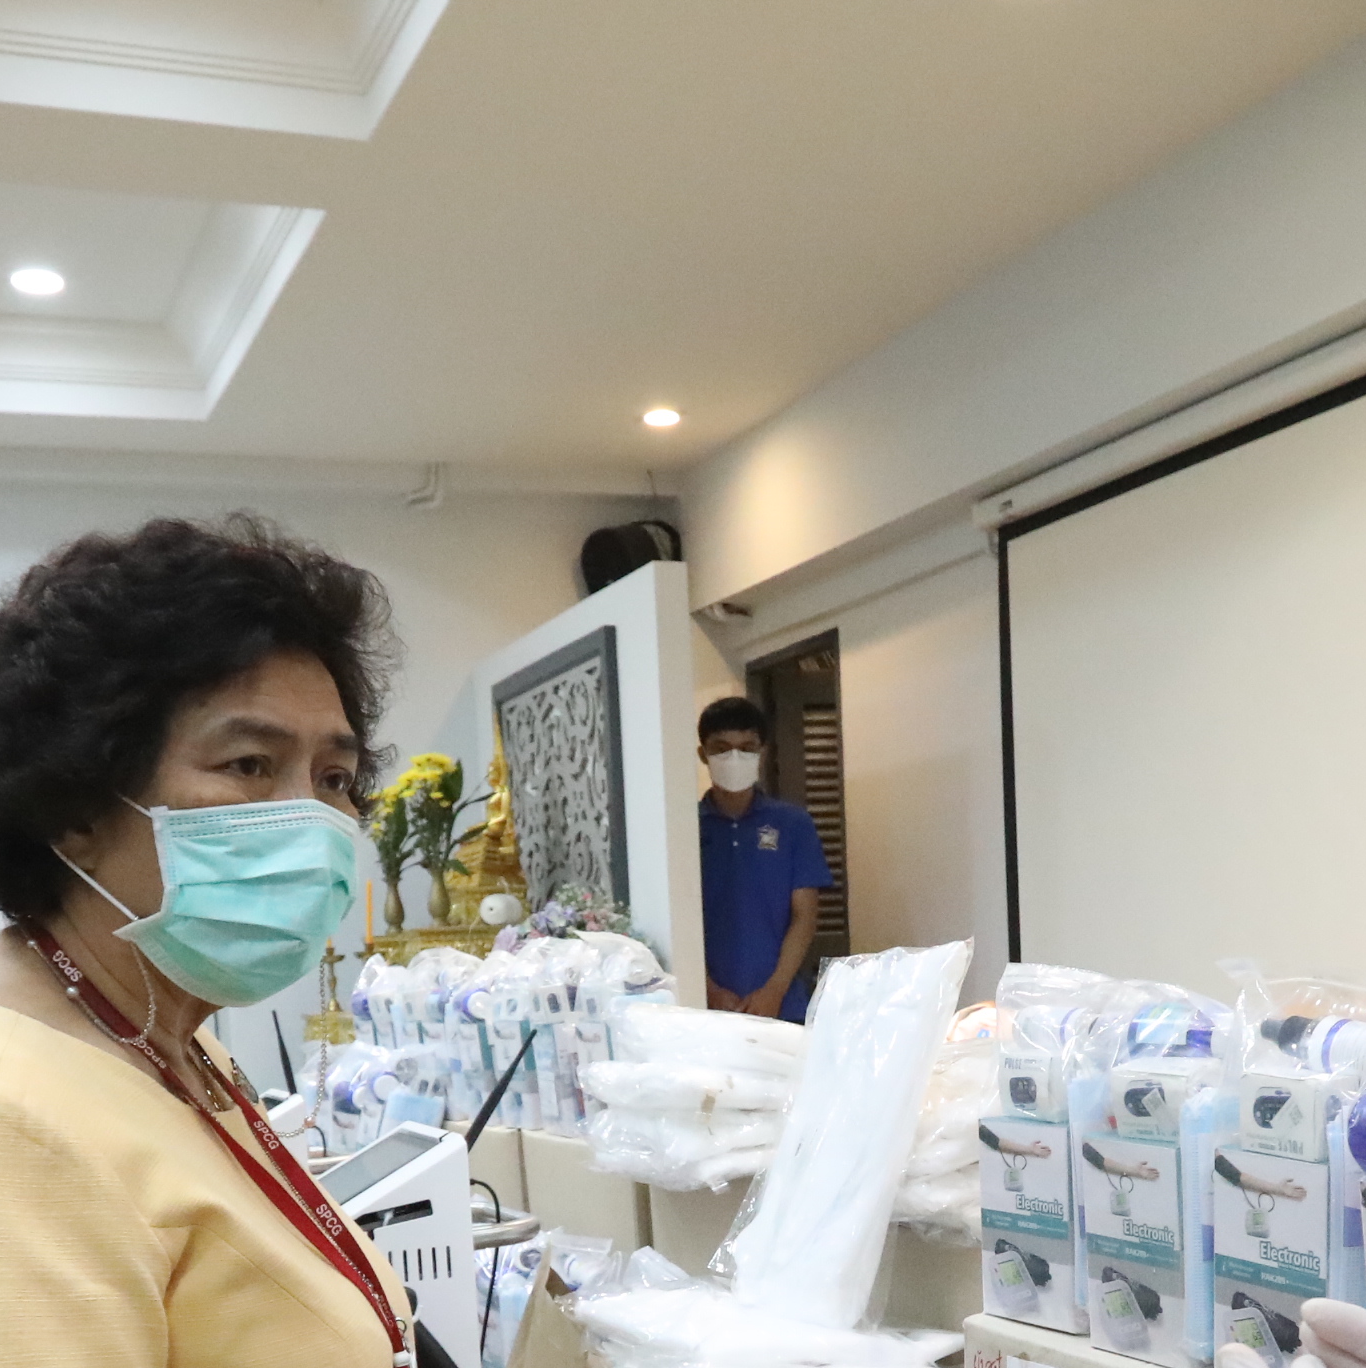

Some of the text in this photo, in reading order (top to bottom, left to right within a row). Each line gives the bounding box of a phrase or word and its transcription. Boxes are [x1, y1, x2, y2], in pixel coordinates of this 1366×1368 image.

[52, 949, 83, 983] SPCG
[253, 1119, 280, 1151] SPCG
[315, 1203, 344, 1238] SPCG
[1015, 1194, 1065, 1219] Electronic
[1123, 1218, 1176, 1245] Electronic
[1259, 1240, 1321, 1272] Electronic
